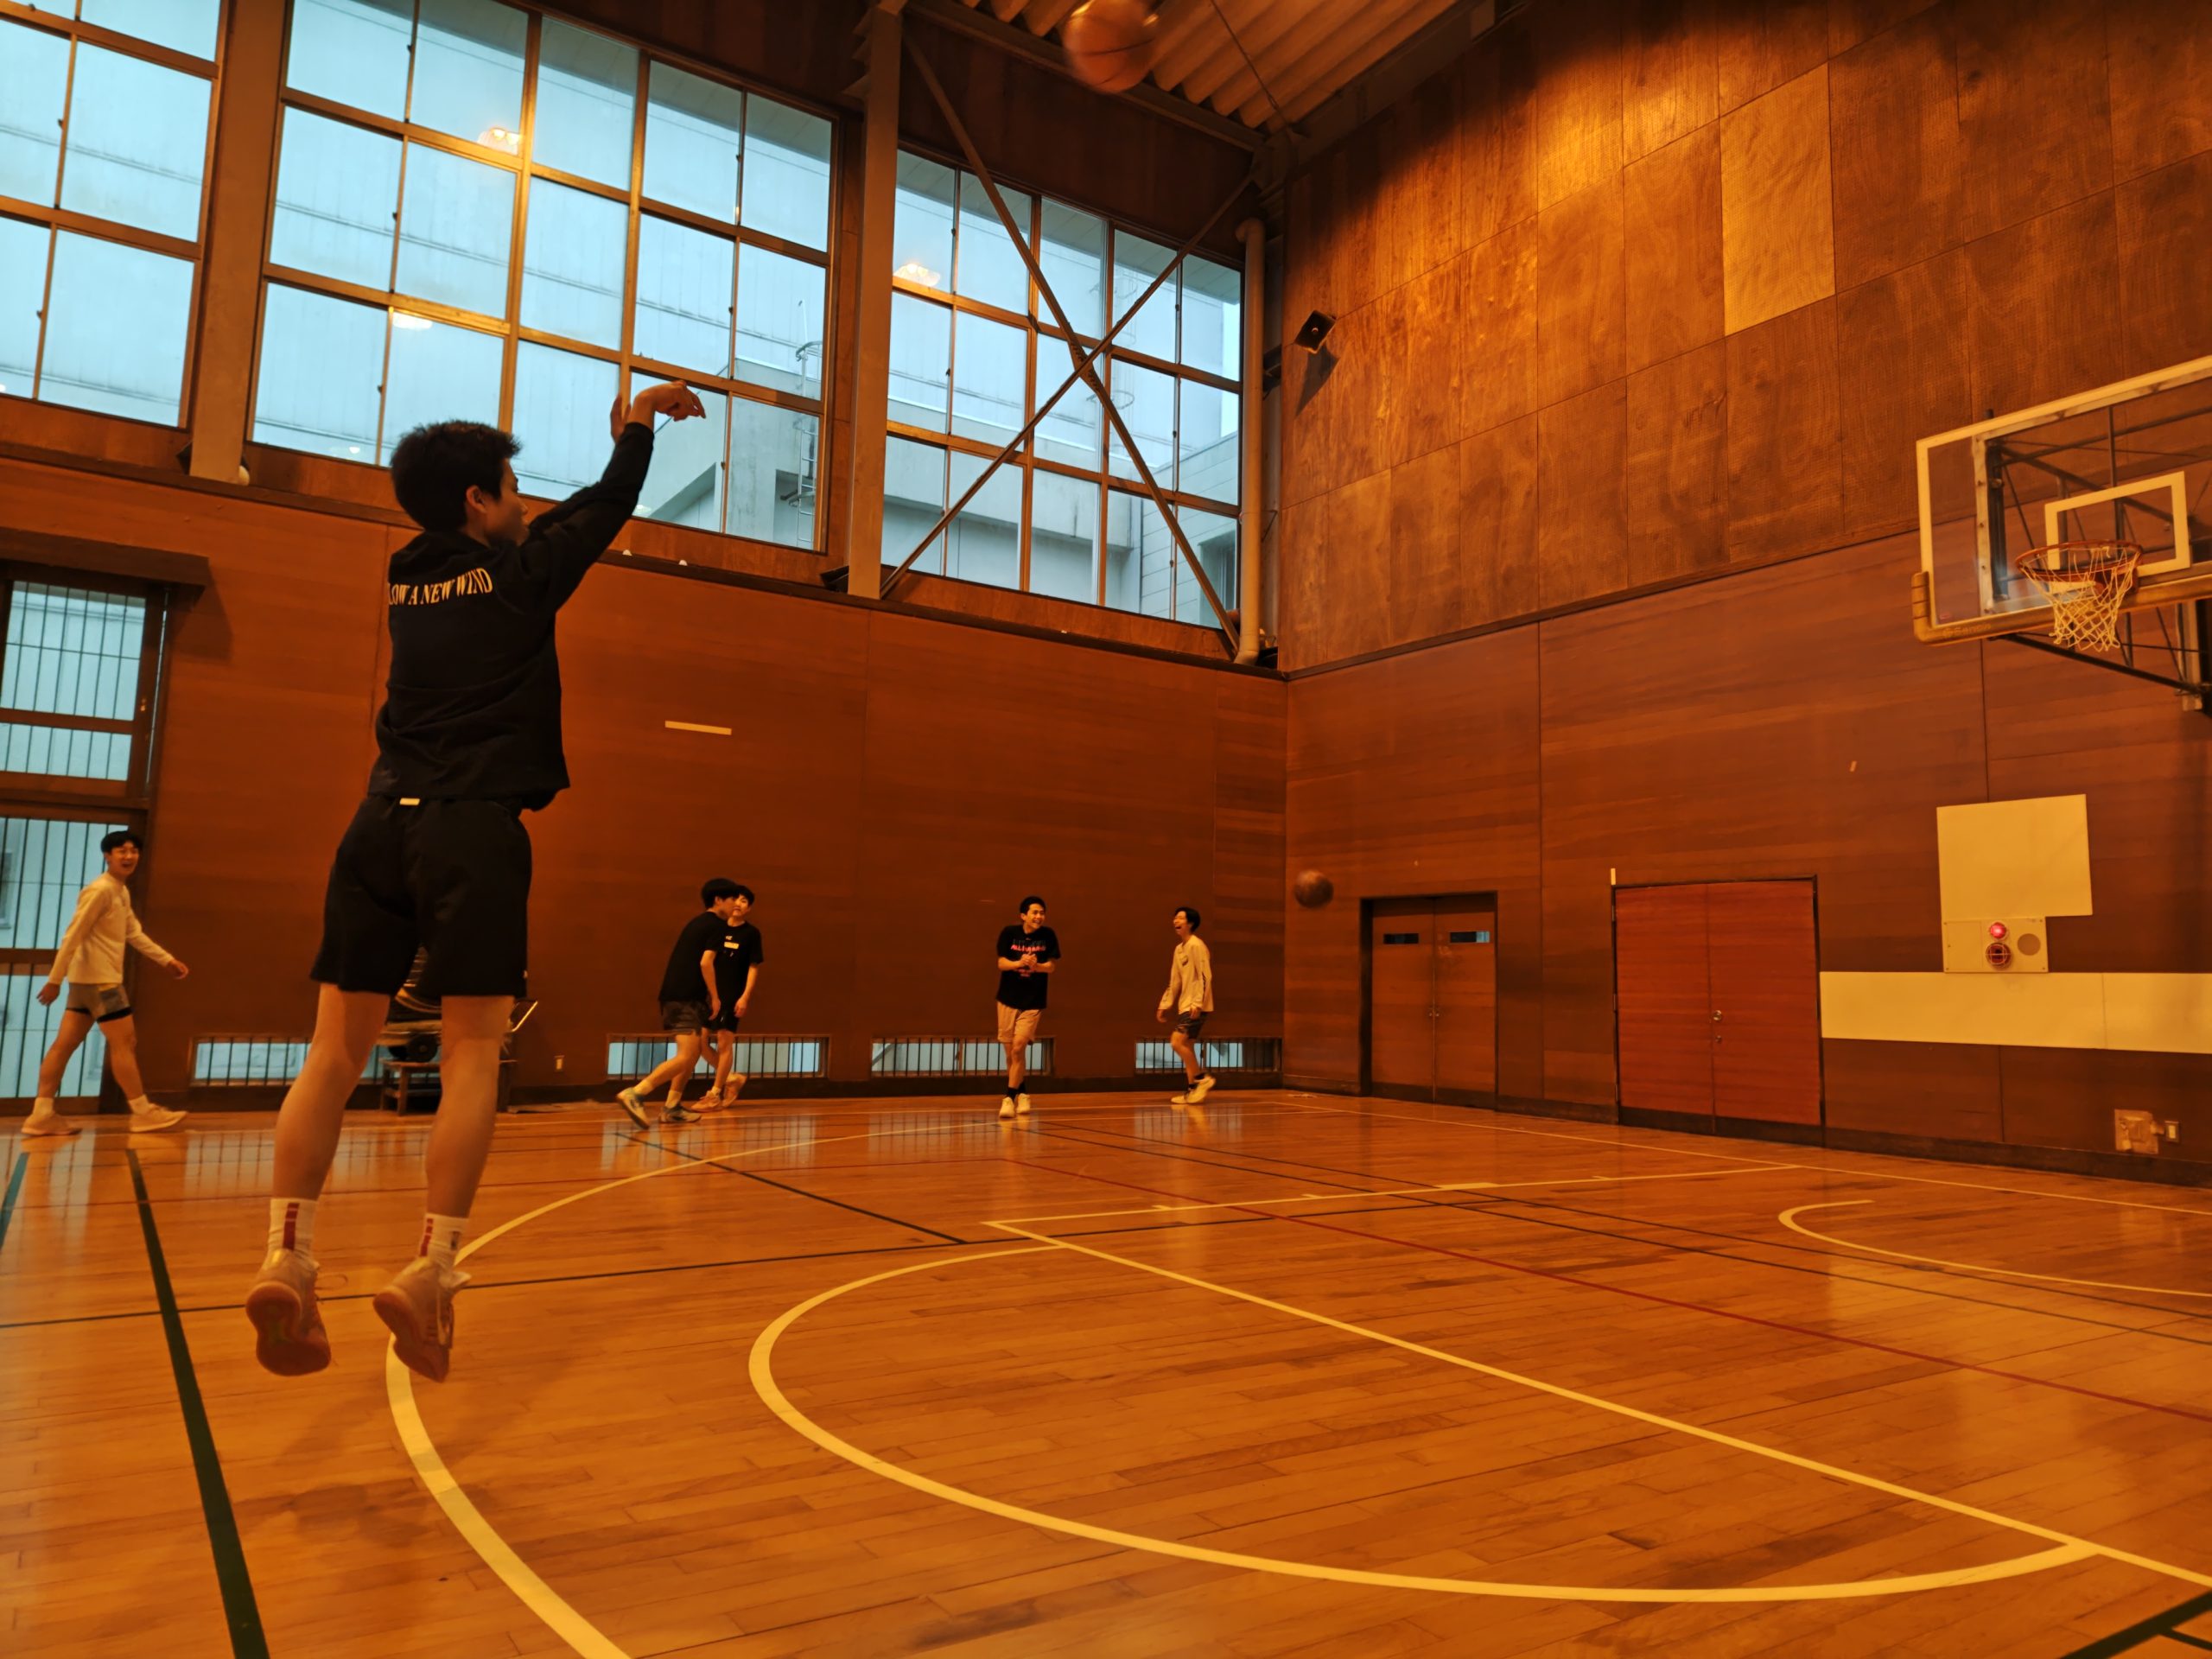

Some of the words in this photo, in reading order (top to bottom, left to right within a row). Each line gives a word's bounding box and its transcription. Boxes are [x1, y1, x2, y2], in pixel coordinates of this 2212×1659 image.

[408, 585, 419, 606] A
[420, 579, 455, 605] NEW
[456, 568, 493, 597] WIND
